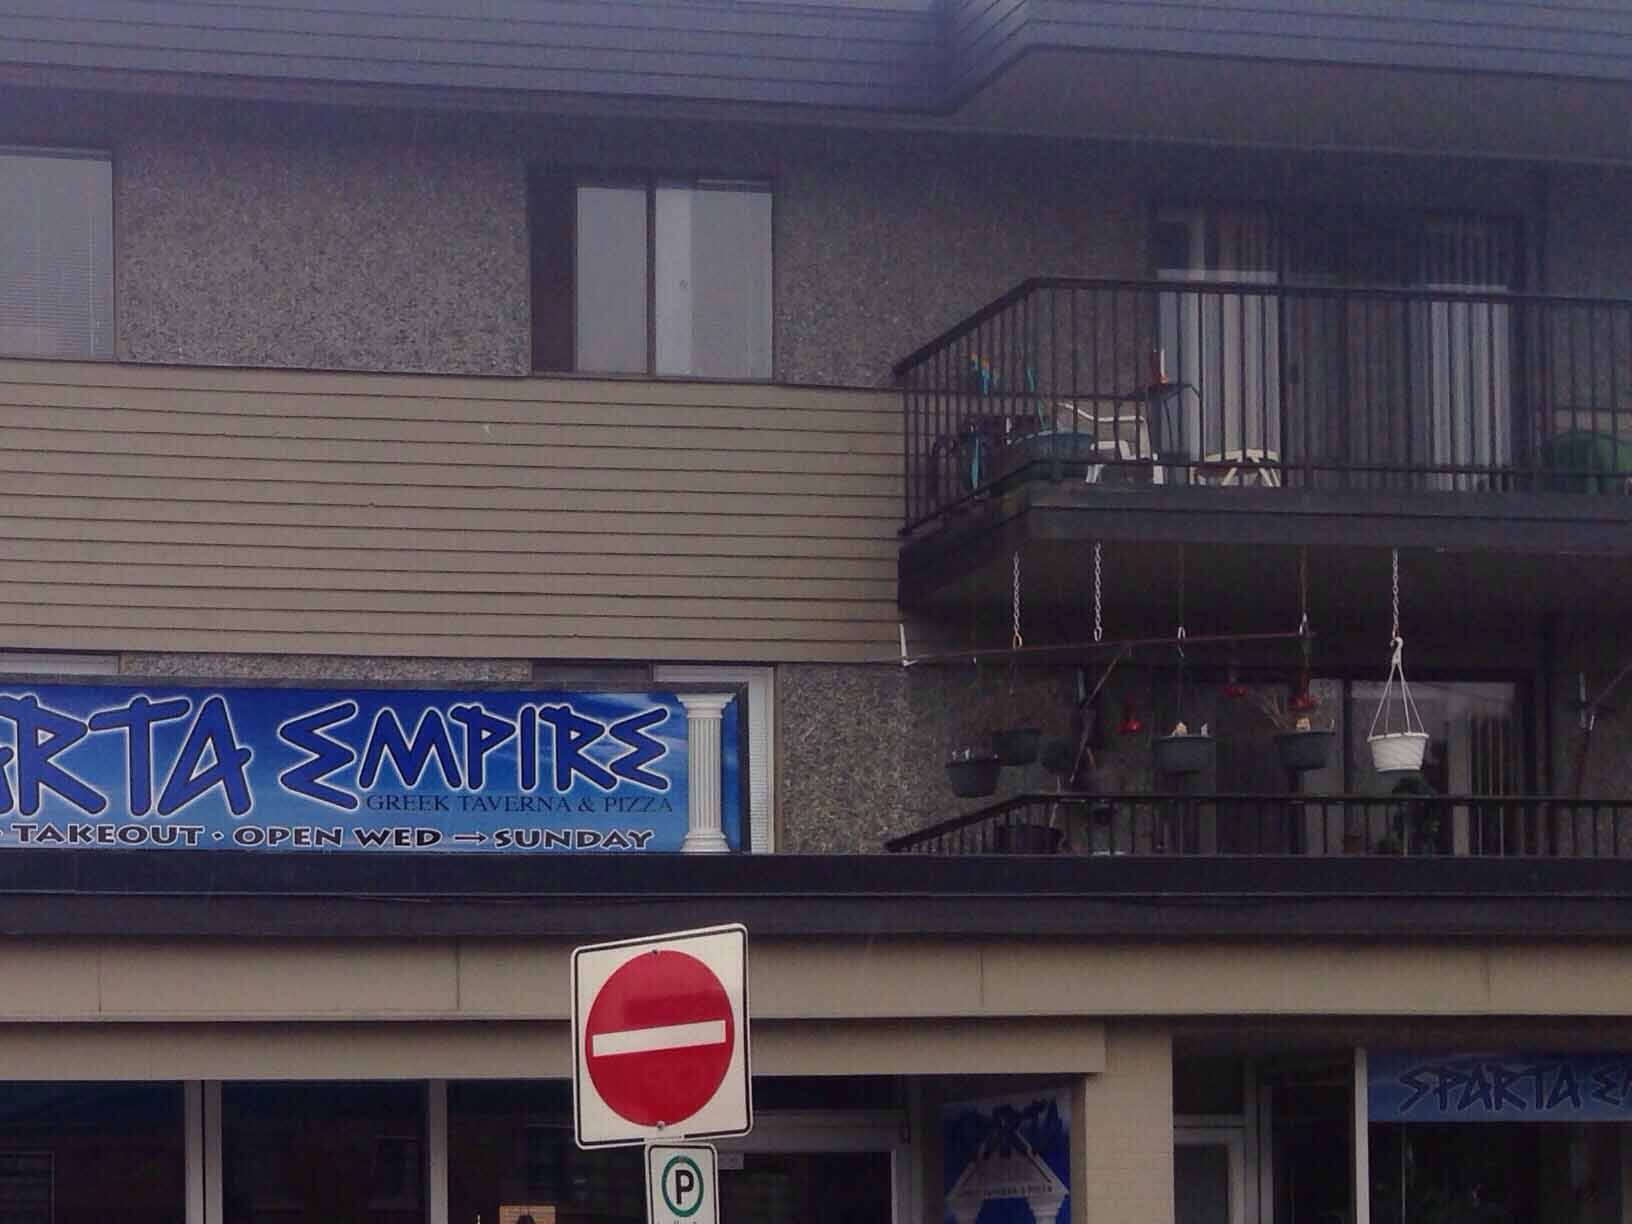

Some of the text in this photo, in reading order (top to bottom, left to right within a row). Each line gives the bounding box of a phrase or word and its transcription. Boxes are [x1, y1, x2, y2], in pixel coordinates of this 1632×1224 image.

[278, 700, 669, 810] EMPIRE
[367, 795, 673, 814] GREEK TAVERNA & PIZZA
[11, 823, 206, 846] TAKEOUT
[233, 826, 343, 848] OPEN
[352, 827, 443, 848] WED
[494, 830, 655, 850] SUNDAY
[1399, 1063, 1581, 1113] SPARTA
[675, 1169, 694, 1205] P
